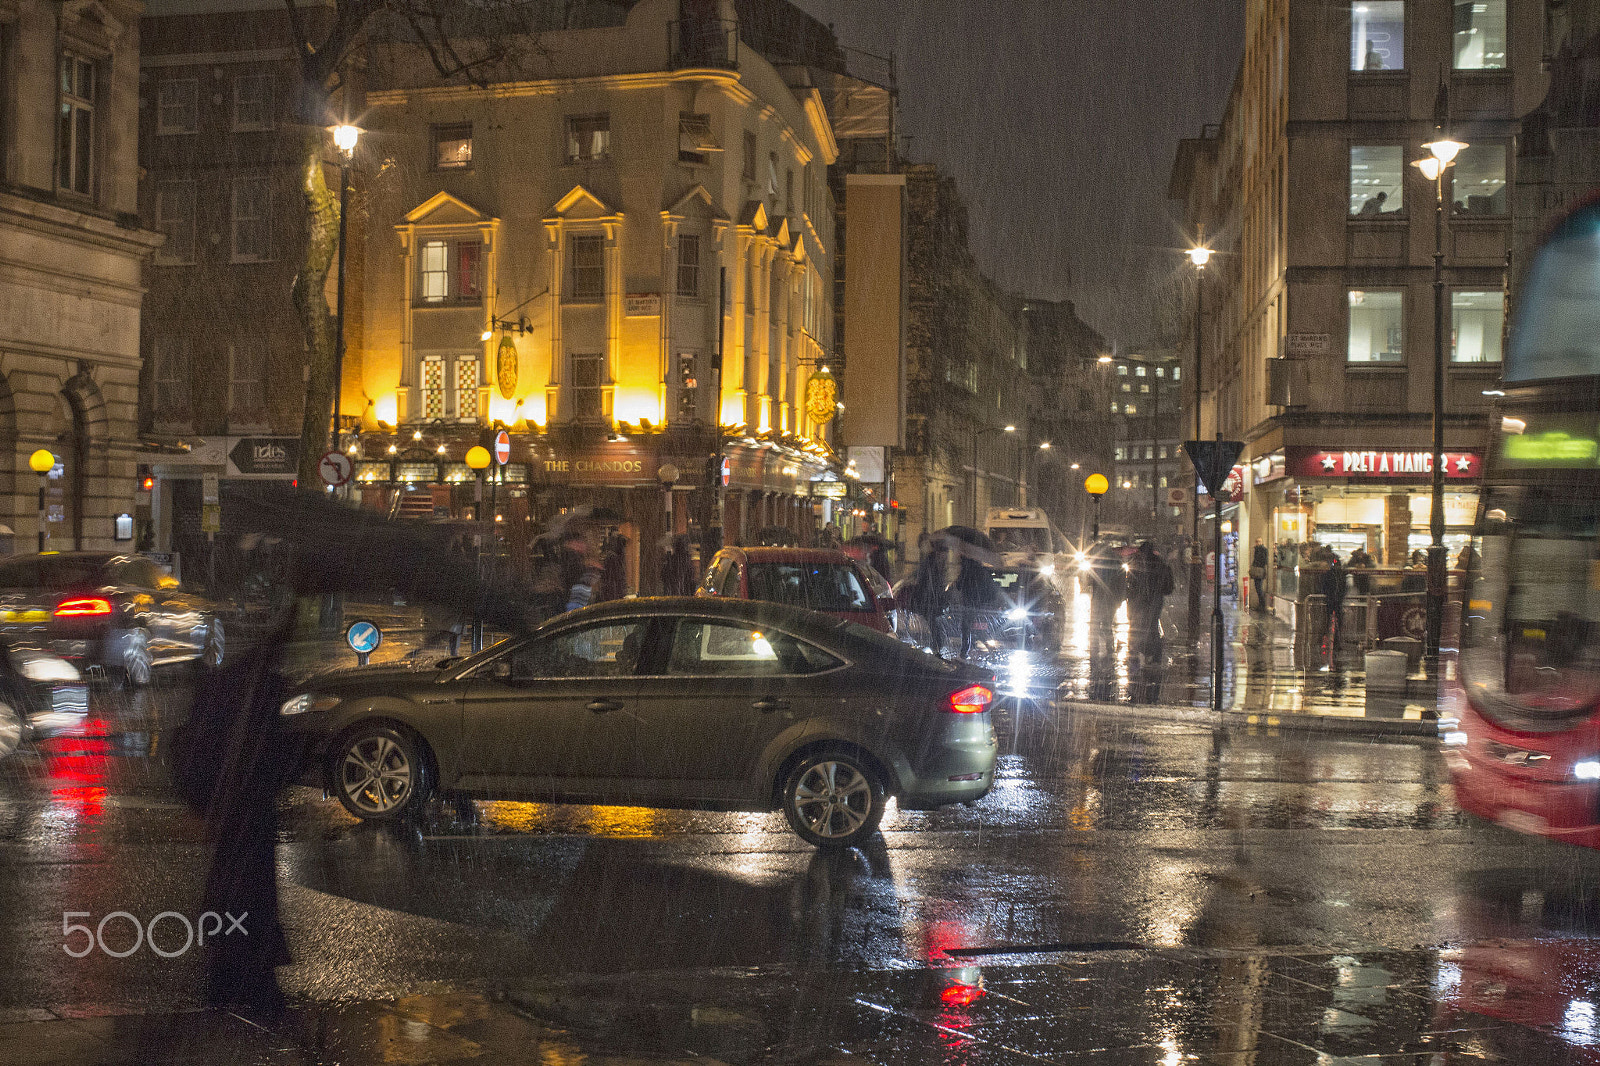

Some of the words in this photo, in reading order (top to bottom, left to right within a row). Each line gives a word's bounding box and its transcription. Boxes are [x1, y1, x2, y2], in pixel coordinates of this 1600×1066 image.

[543, 460, 570, 472] THE
[576, 460, 642, 472] CHANDOS
[1342, 451, 1376, 472] PRET
[1379, 452, 1389, 472] A
[1393, 452, 1448, 473] MANGR
